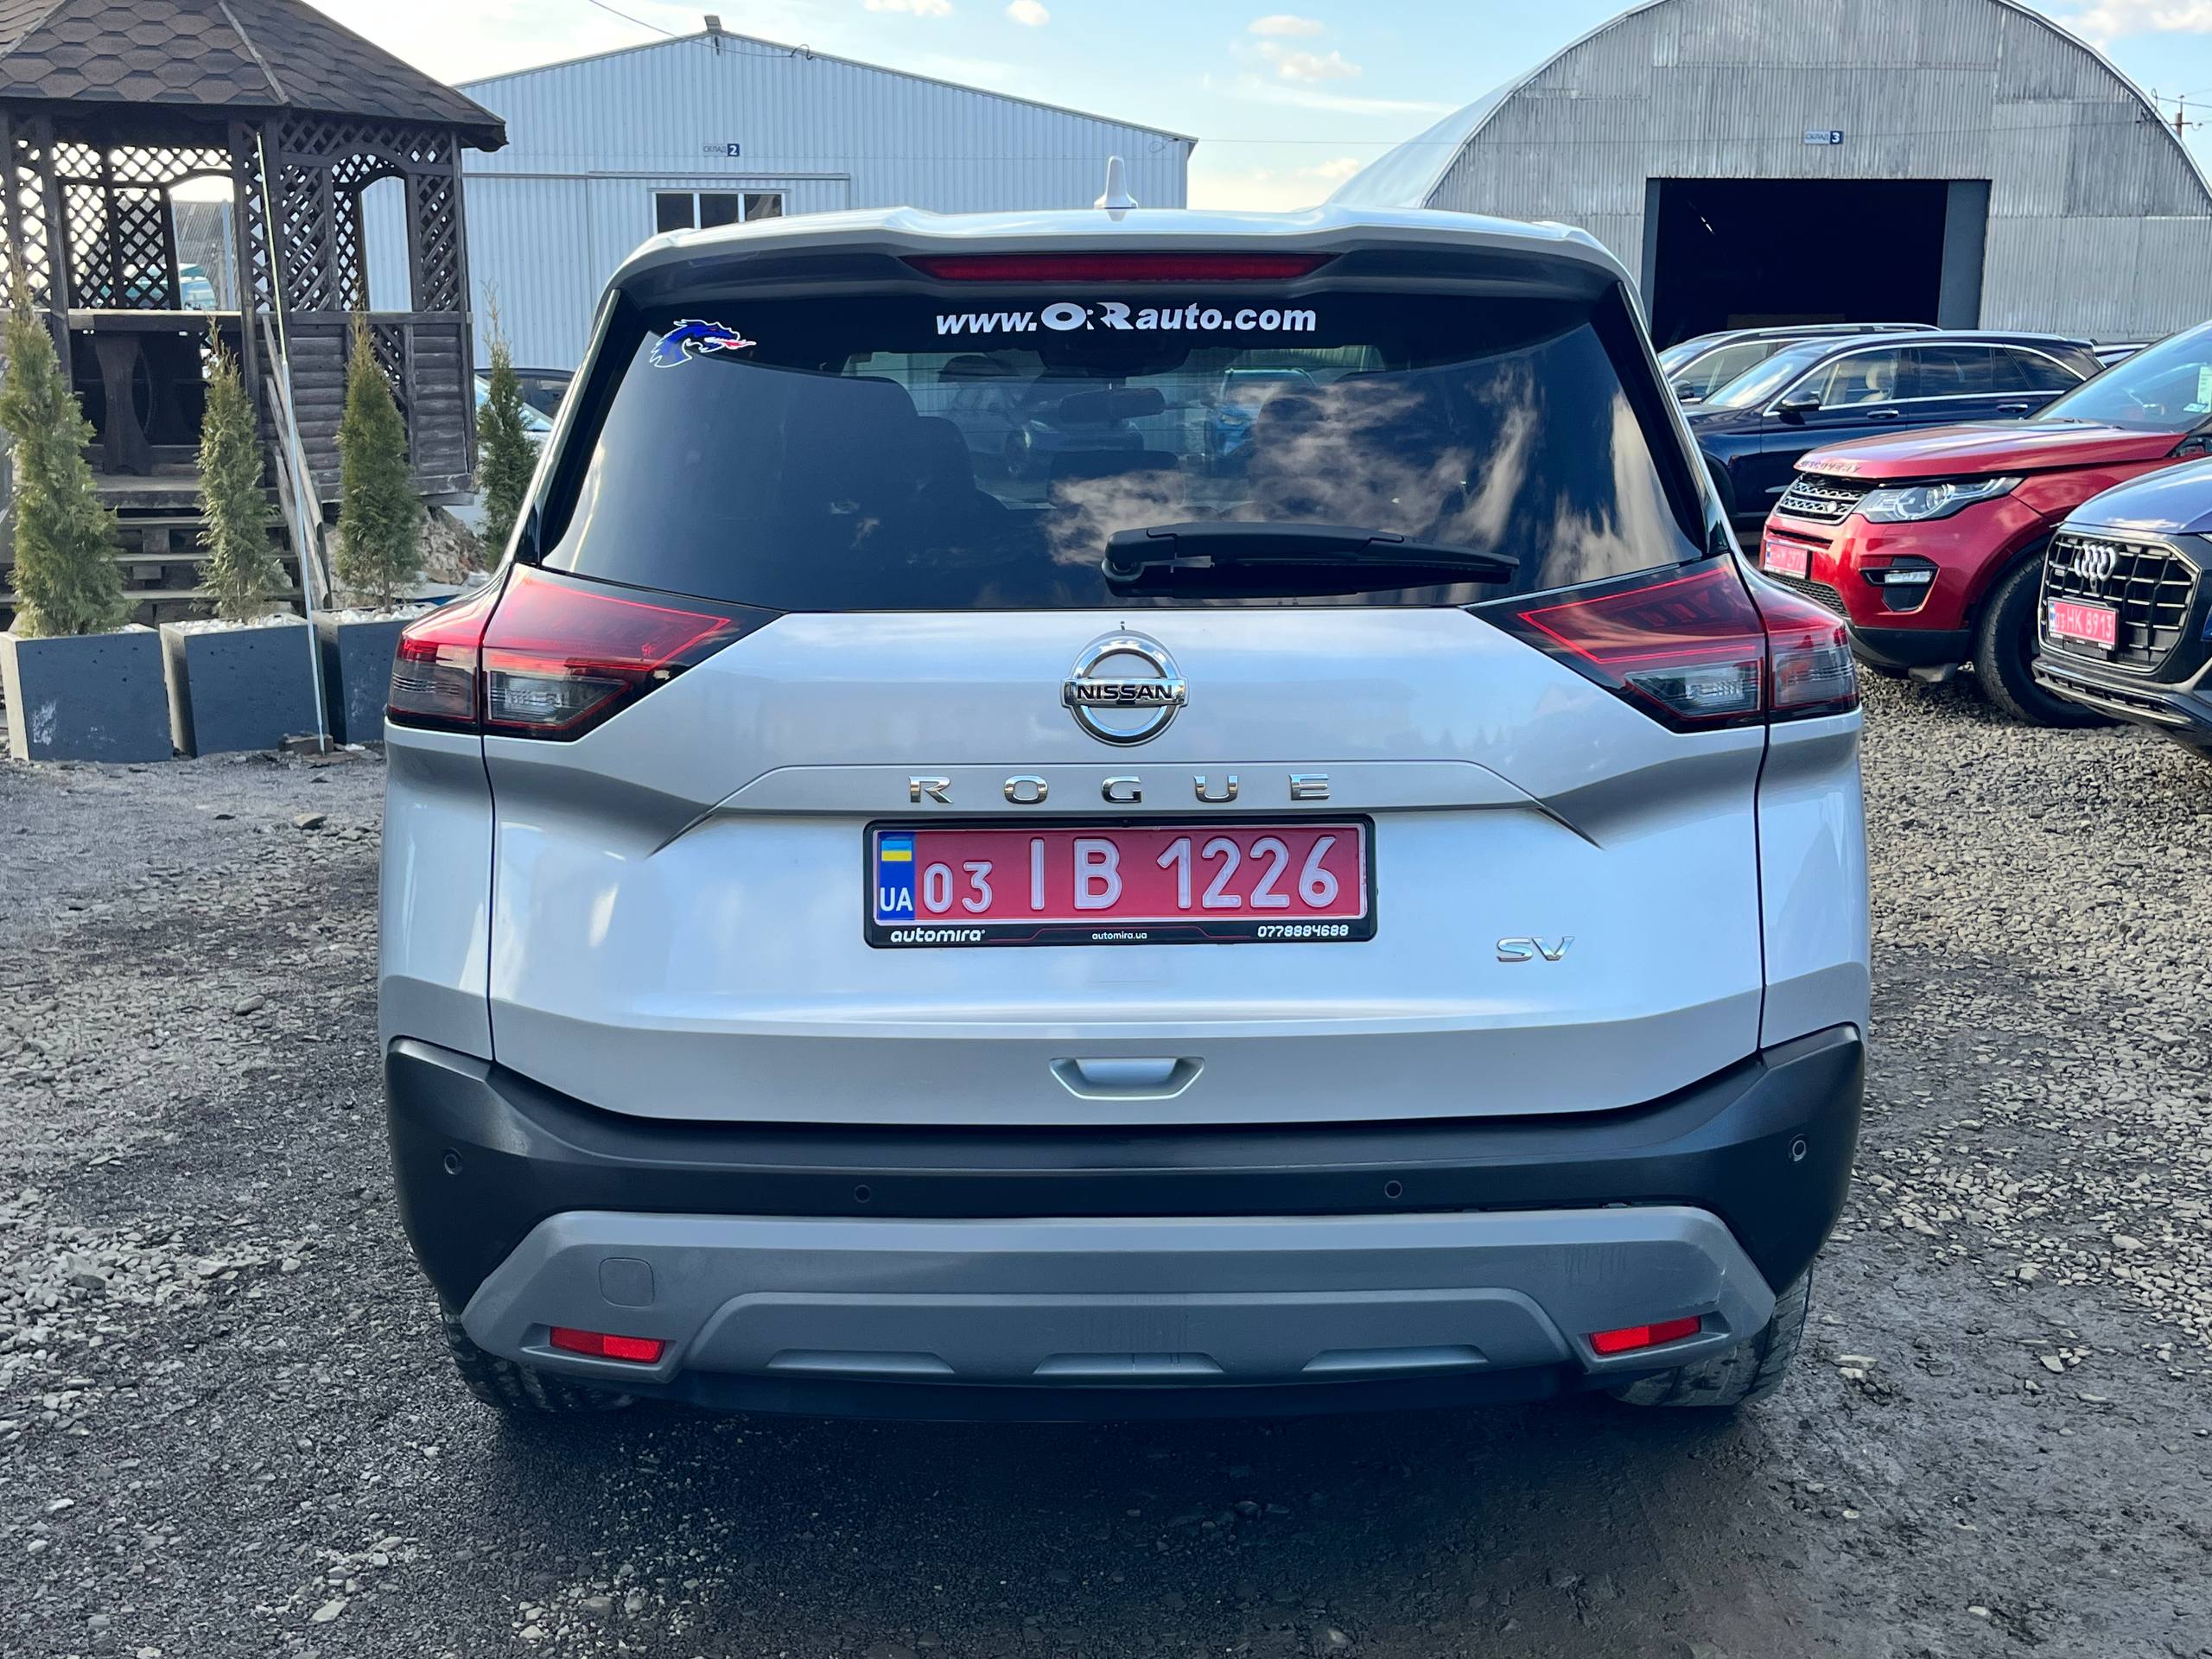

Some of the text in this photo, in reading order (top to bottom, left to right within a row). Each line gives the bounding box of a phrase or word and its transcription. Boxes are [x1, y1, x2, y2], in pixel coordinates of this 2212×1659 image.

[1832, 131, 1840, 143] 3
[729, 144, 738, 156] 2
[1077, 684, 1173, 700] NISSAN
[908, 773, 1331, 804] ROGUE
[923, 862, 993, 913] 03
[1156, 836, 1339, 909] 1226
[880, 887, 913, 912] UA
[890, 926, 982, 943] automira
[1091, 930, 1147, 940] automira.ua
[1257, 925, 1350, 938] 0778884688
[1497, 936, 1575, 963] SV
